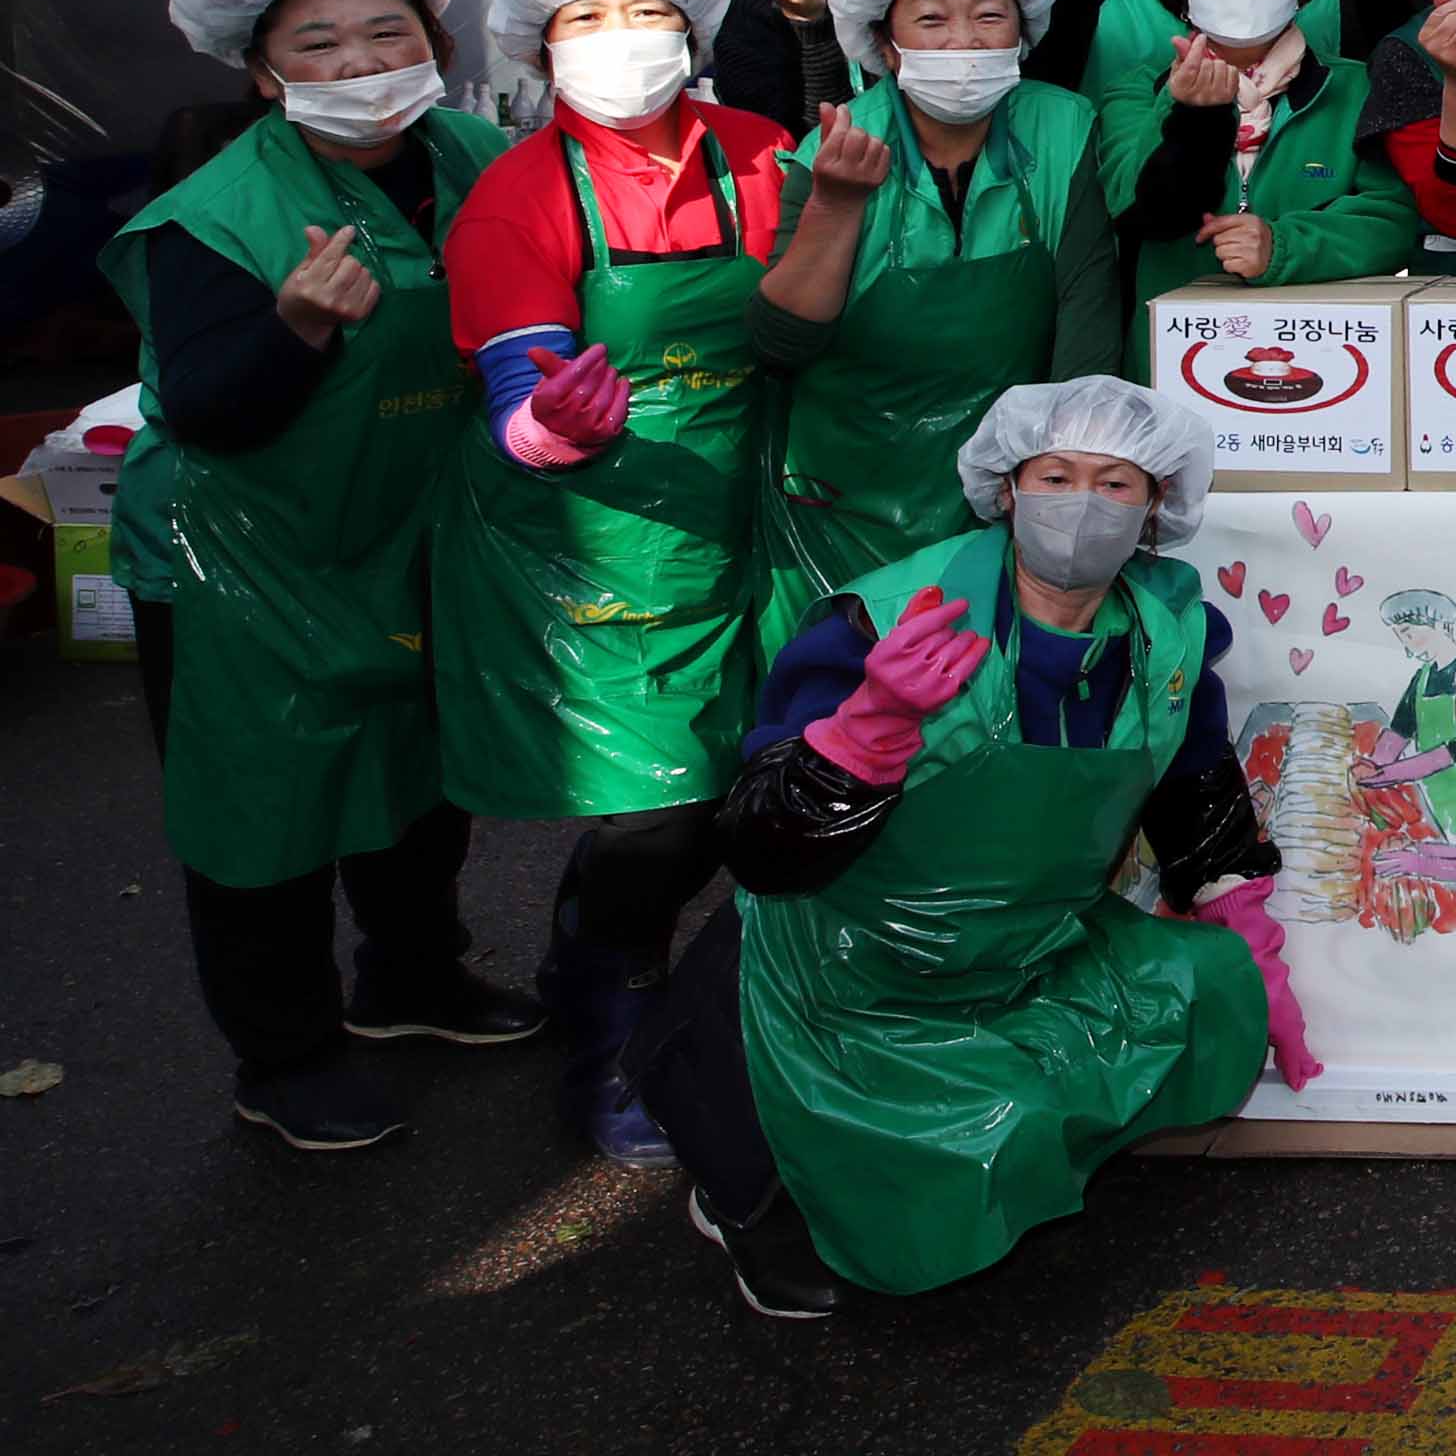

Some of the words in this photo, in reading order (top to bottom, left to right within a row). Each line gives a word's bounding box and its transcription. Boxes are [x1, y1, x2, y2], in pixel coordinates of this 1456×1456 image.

[1273, 319, 1379, 346] 김장나눔
[1217, 434, 1241, 452] 2동
[1250, 434, 1342, 454] 새마을부녀회
